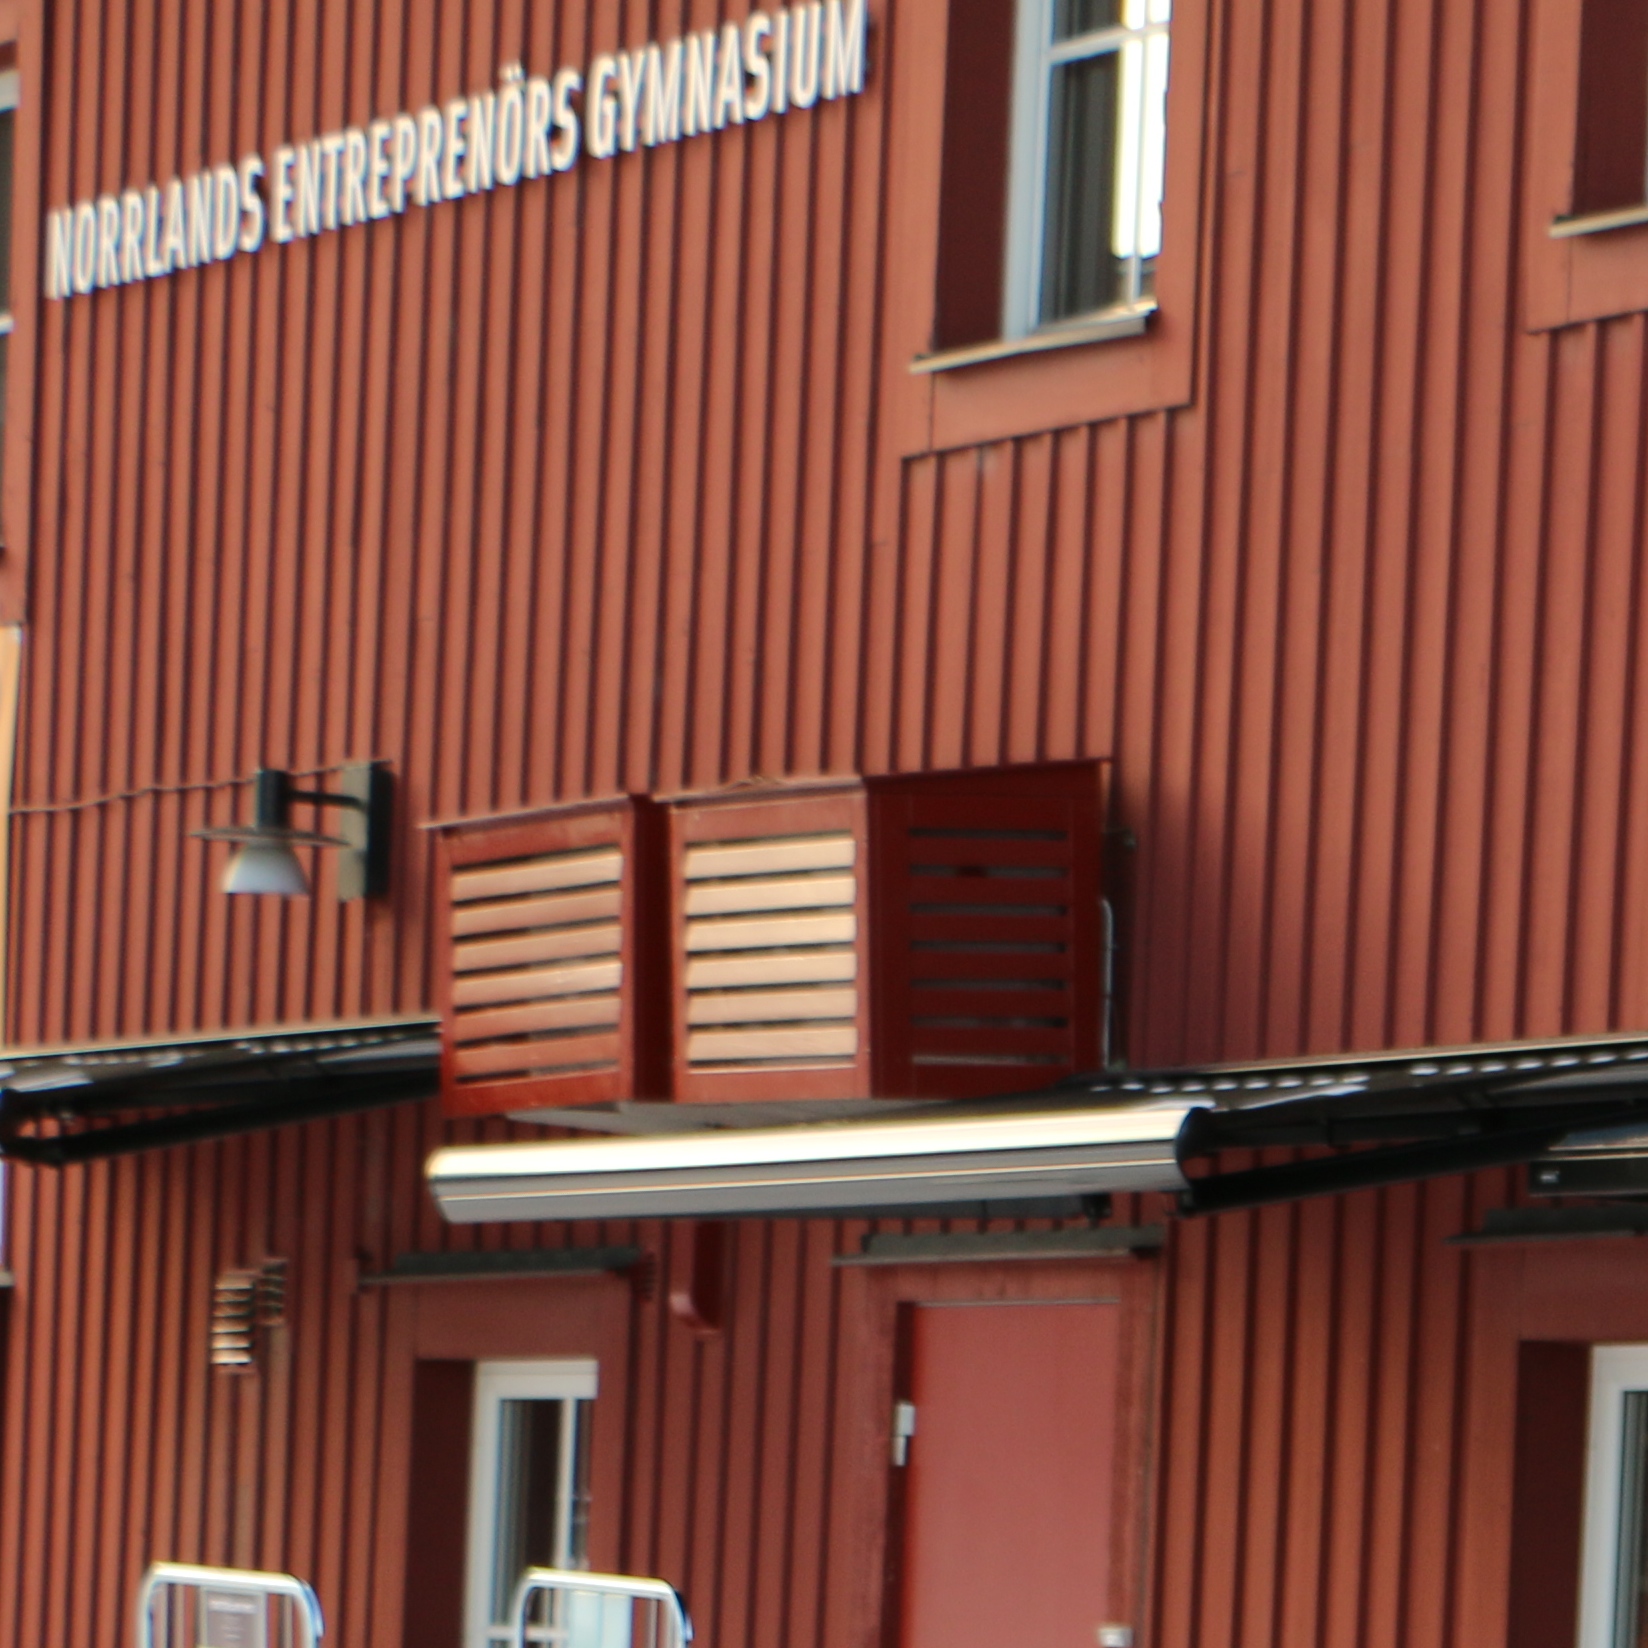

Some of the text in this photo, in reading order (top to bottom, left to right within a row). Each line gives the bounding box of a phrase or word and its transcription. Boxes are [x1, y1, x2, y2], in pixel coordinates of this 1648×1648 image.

[46, 0, 869, 300] NORRLANDS ENTREPRENÖRS GYMNASIUM
